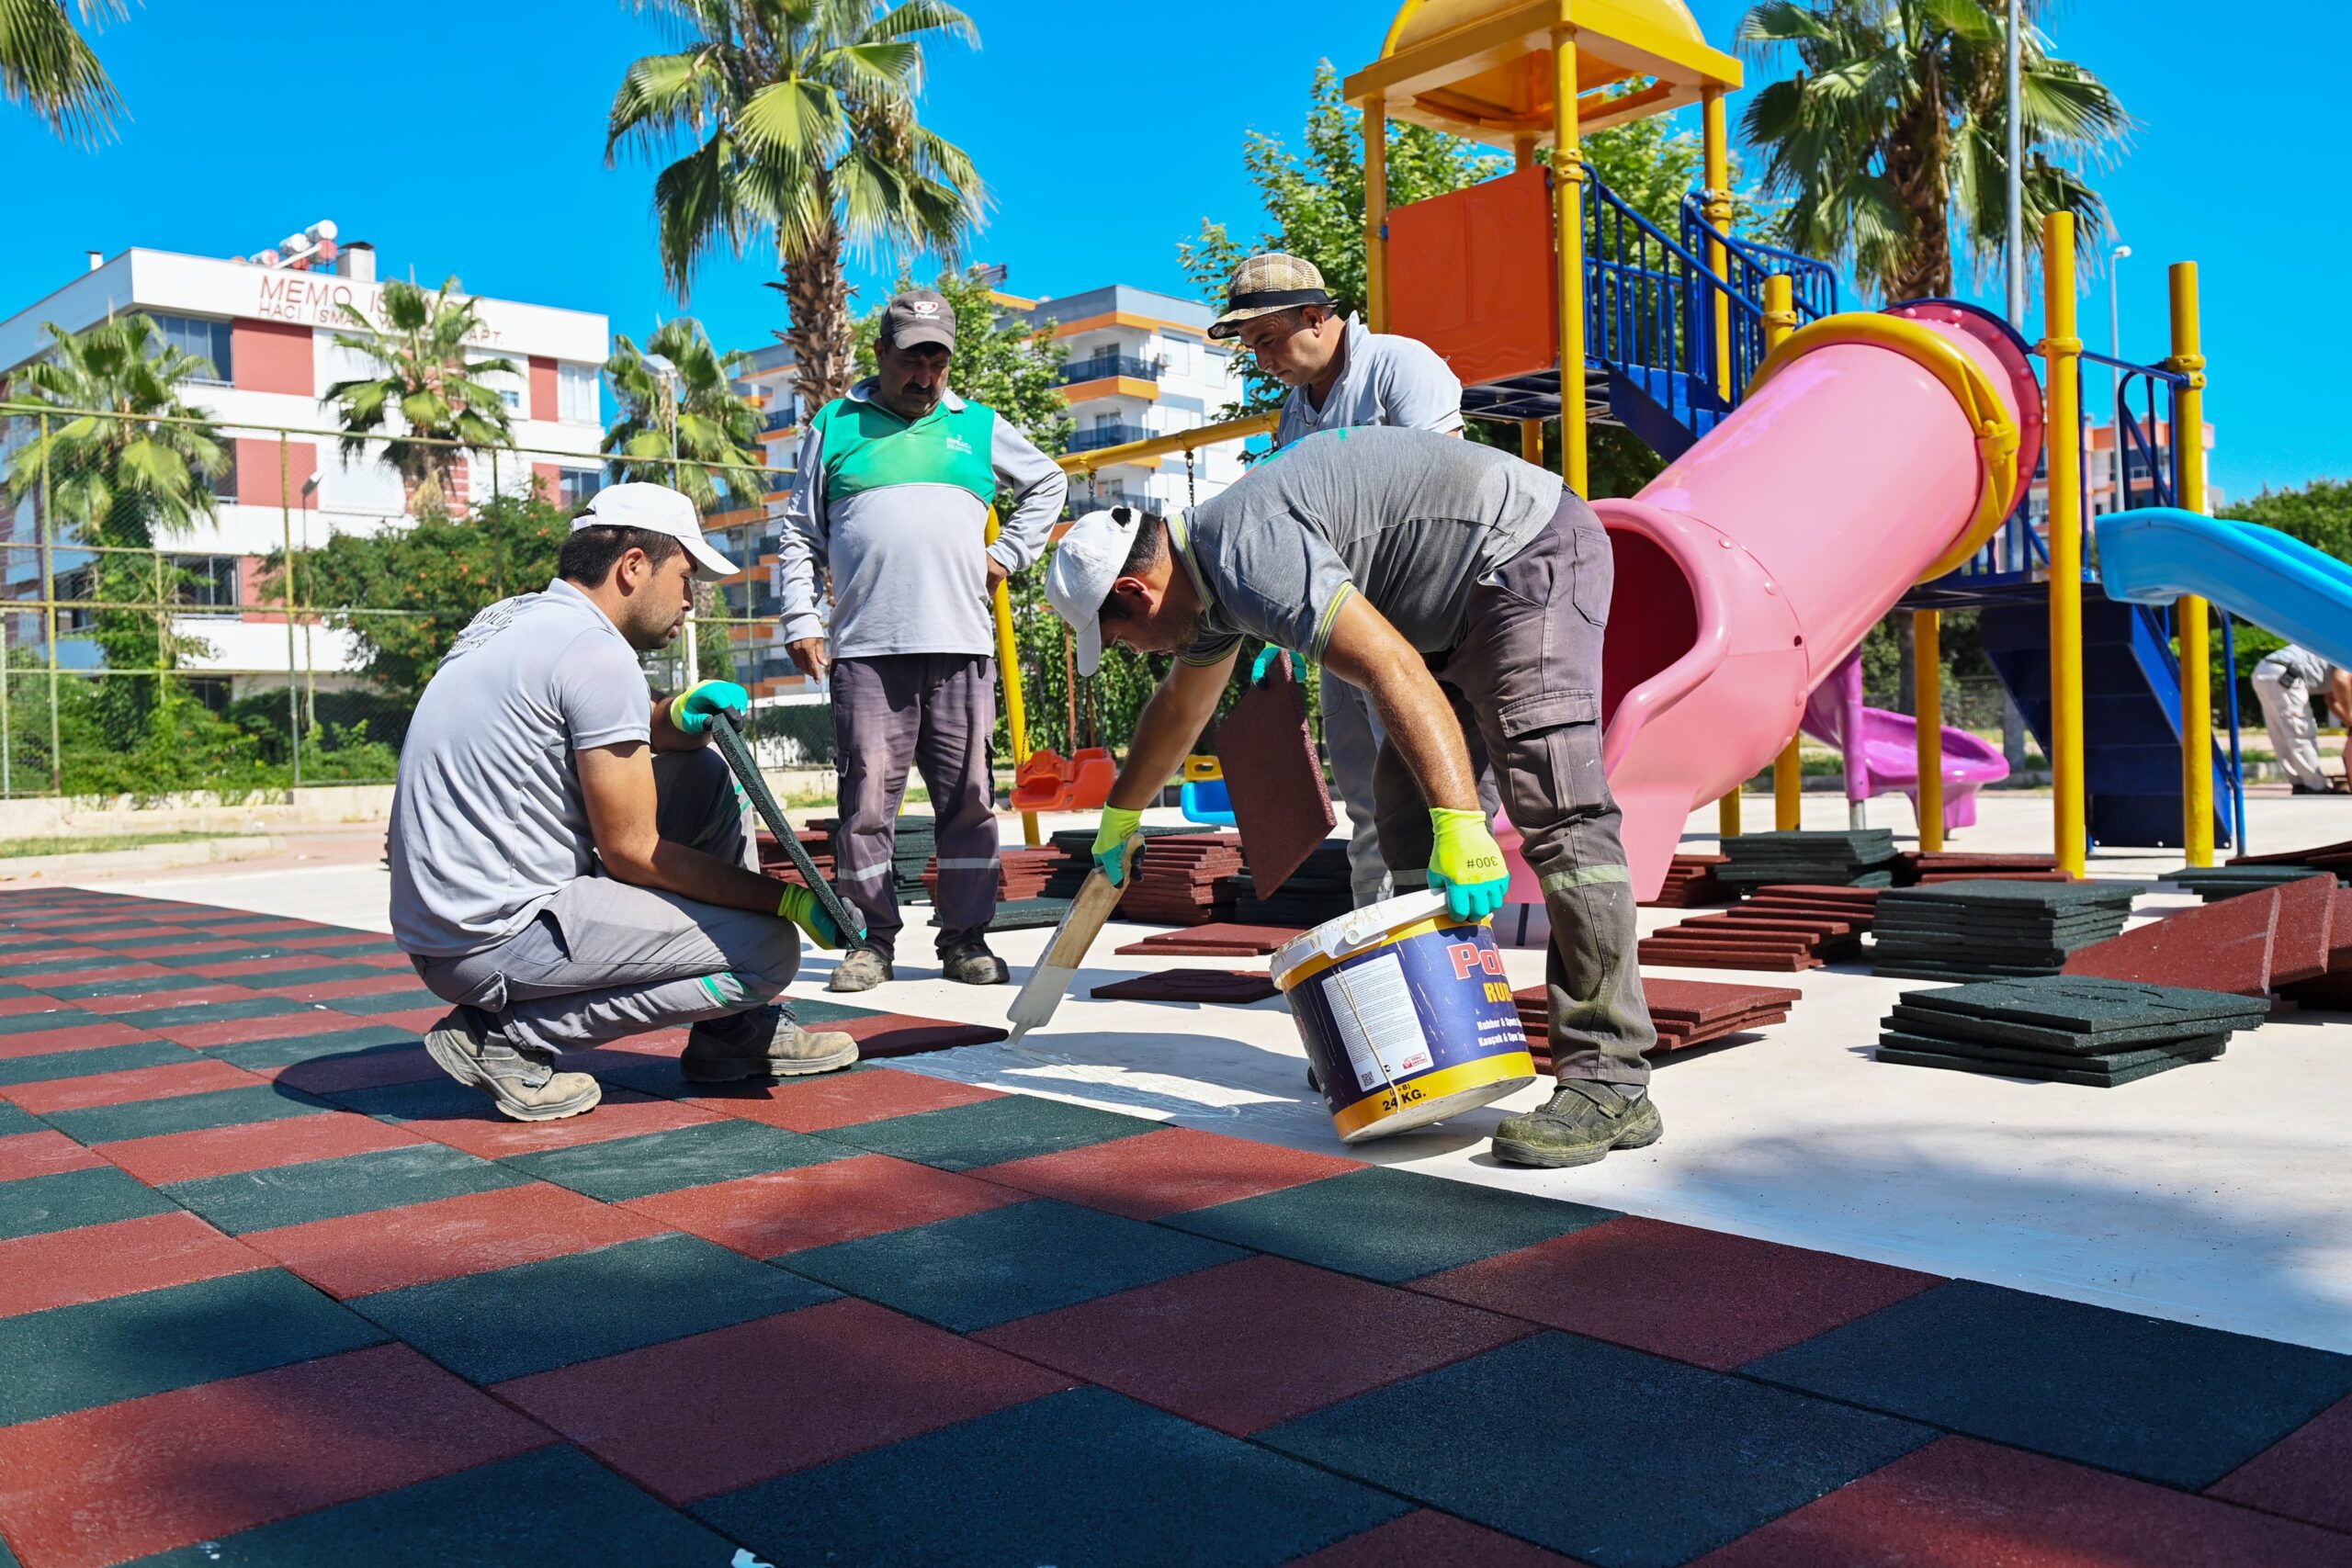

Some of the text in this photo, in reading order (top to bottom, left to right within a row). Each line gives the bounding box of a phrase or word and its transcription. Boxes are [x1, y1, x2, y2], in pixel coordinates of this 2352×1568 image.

[260, 276, 352, 307] MEMO
[1476, 1019, 1500, 1031] Rubber
[1383, 1089, 1427, 1111] 24 KG.
